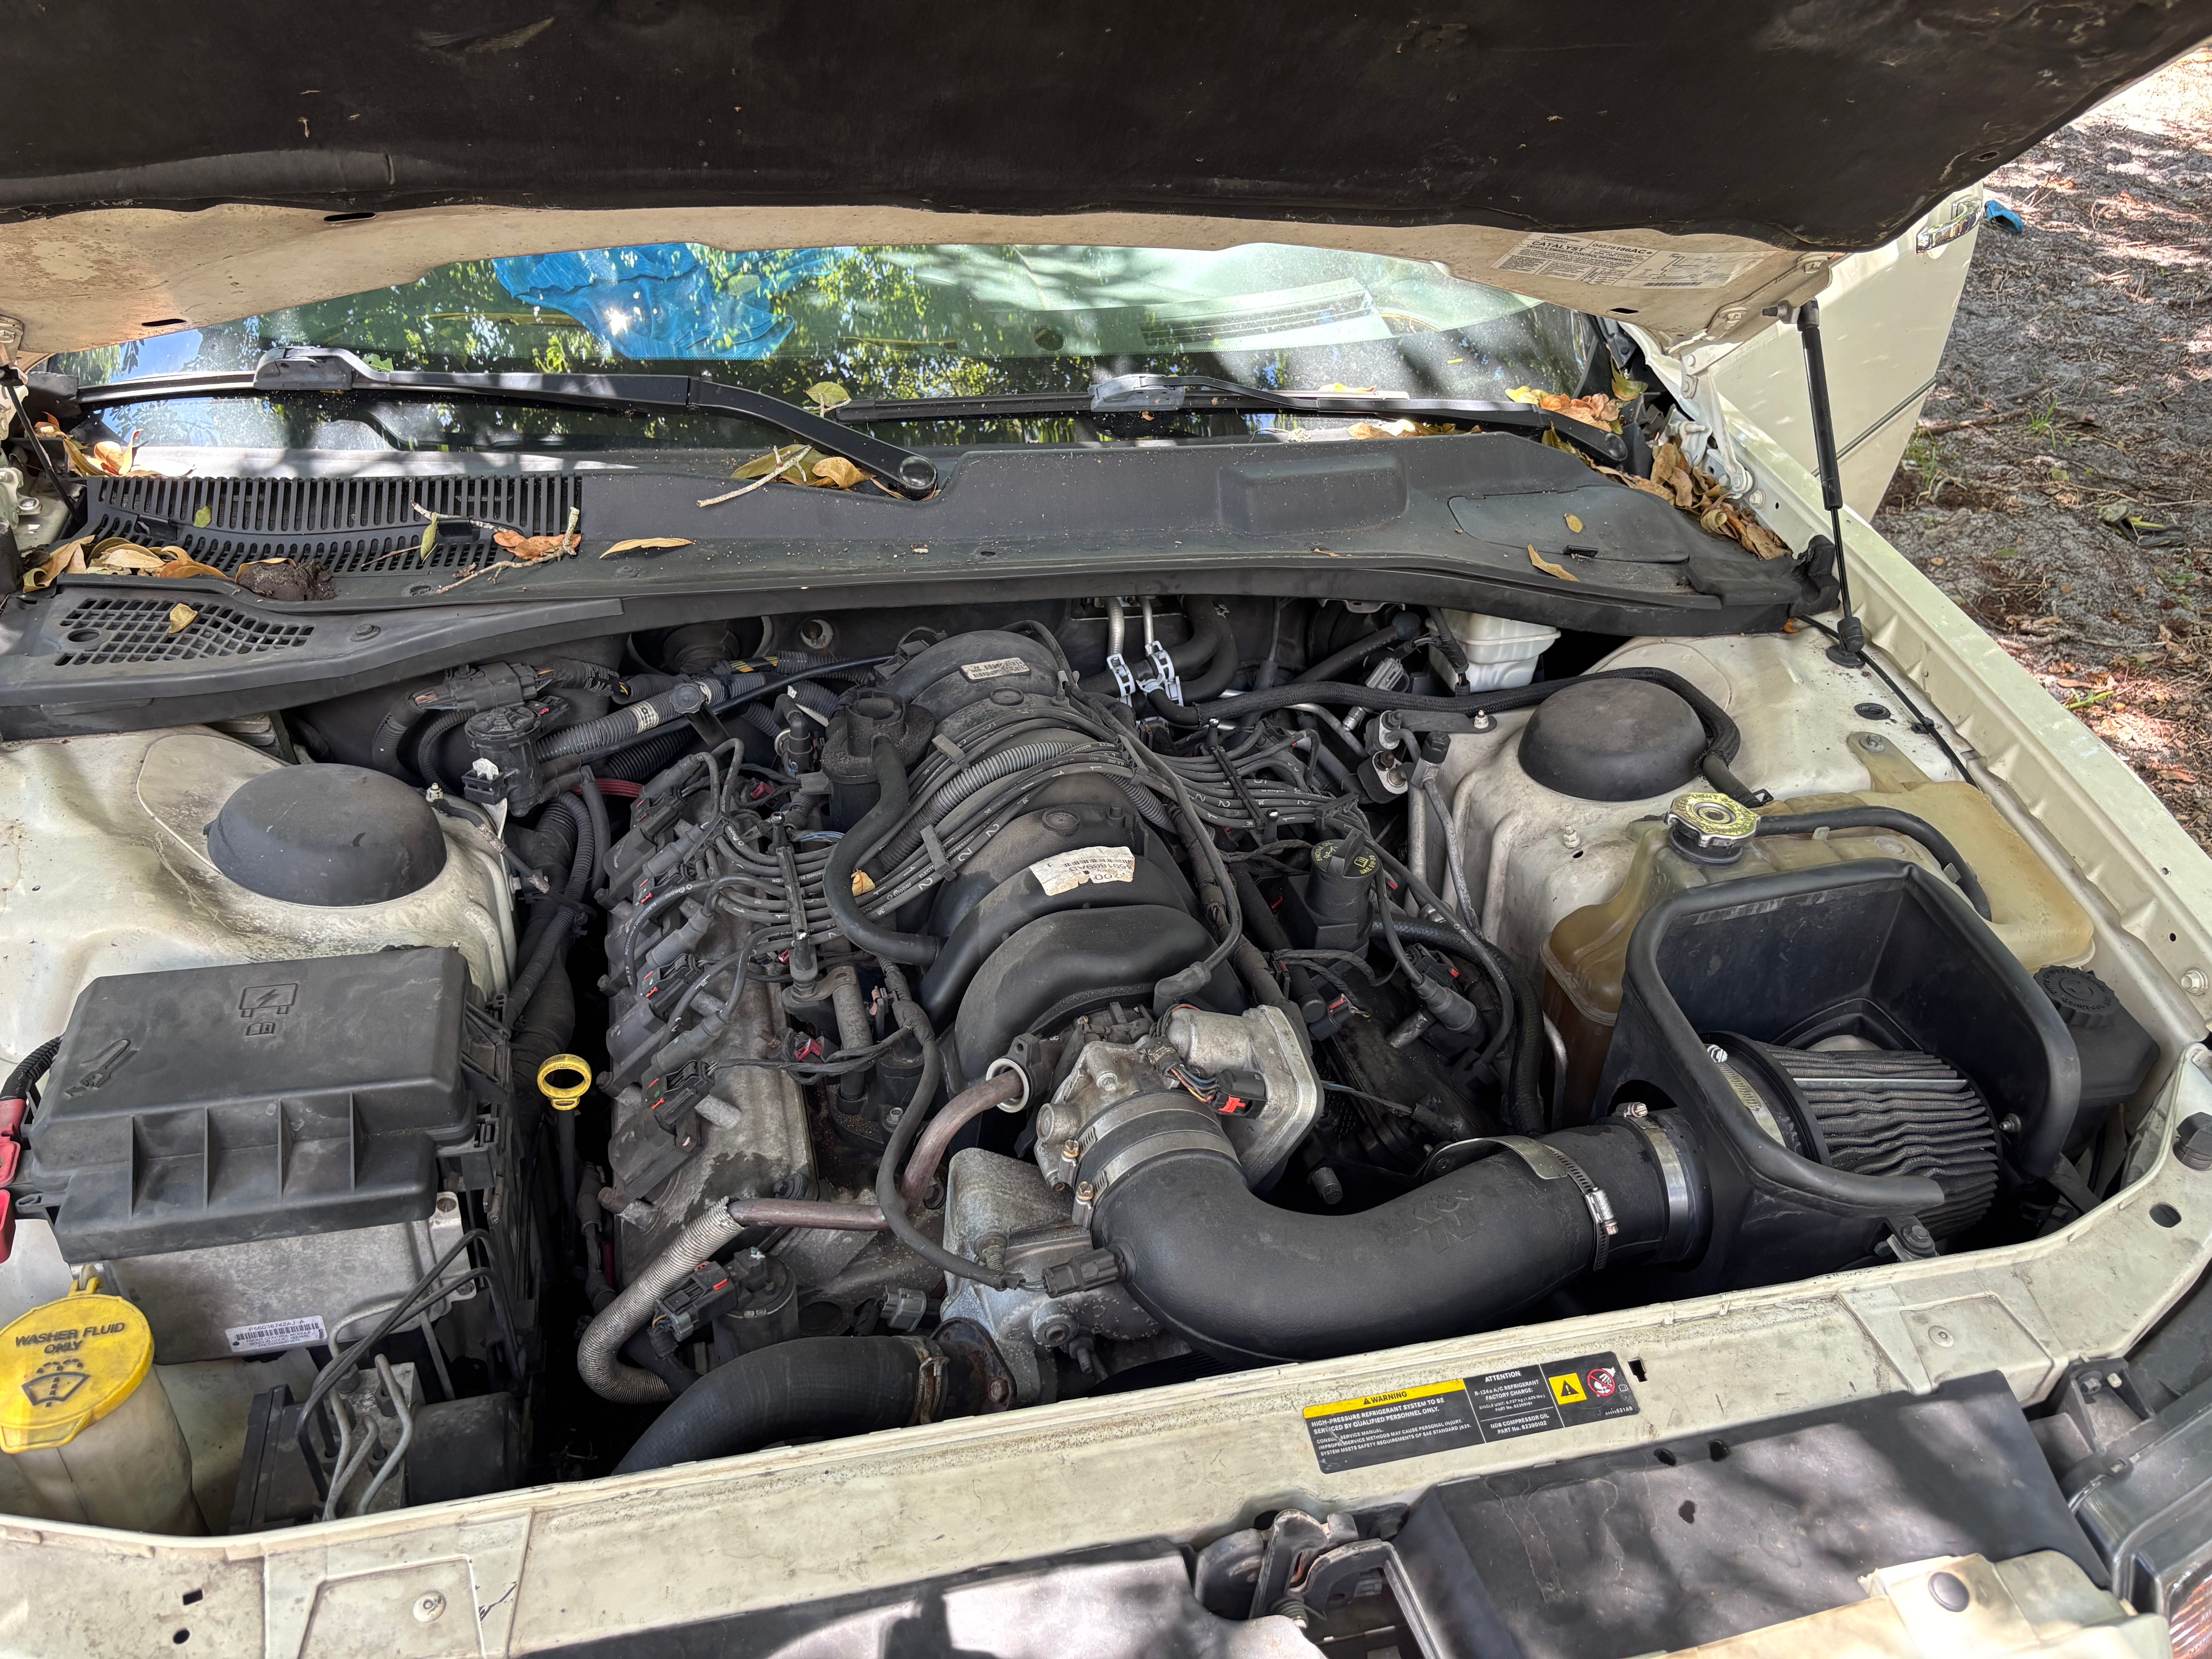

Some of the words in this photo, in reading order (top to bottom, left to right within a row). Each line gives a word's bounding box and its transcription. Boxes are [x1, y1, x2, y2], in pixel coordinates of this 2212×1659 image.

[1532, 241, 1586, 251] CATALYST
[1314, 845, 1325, 861] ENGINE
[15, 1329, 79, 1347] WASHER
[83, 1322, 125, 1337] FLUID
[44, 1340, 84, 1354] ONLY
[1485, 1370, 1522, 1383] ATTENTION
[1504, 1379, 1539, 1390] REFRIGERANT
[1370, 1391, 1408, 1403] WARNING
[1485, 1392, 1509, 1401] FACTORY
[1510, 1388, 1534, 1396] CHARGE:
[1311, 1413, 1361, 1427] HIGH-PRESSURE
[1361, 1405, 1402, 1418] REFRIGERANT
[1403, 1400, 1426, 1410] SYSTEM
[1314, 1424, 1343, 1434] SERVICED
[1353, 1416, 1385, 1427] QUALIFIED
[1386, 1410, 1422, 1421] PERSONNEL
[1503, 1415, 1539, 1426] COMPRESSOR
[1340, 1432, 1361, 1440] SERVICE
[1361, 1428, 1384, 1436] MANUAL.
[1345, 1437, 1365, 1446] SERVICE
[1366, 1432, 1390, 1441] METHODS
[1402, 1426, 1418, 1434] CAUSE
[1419, 1422, 1444, 1431] PERSONAL
[1358, 1441, 1376, 1449] SAFETY
[1377, 1434, 1414, 1446] REQUIREMENTS
[1433, 1426, 1458, 1434] STANDARD
